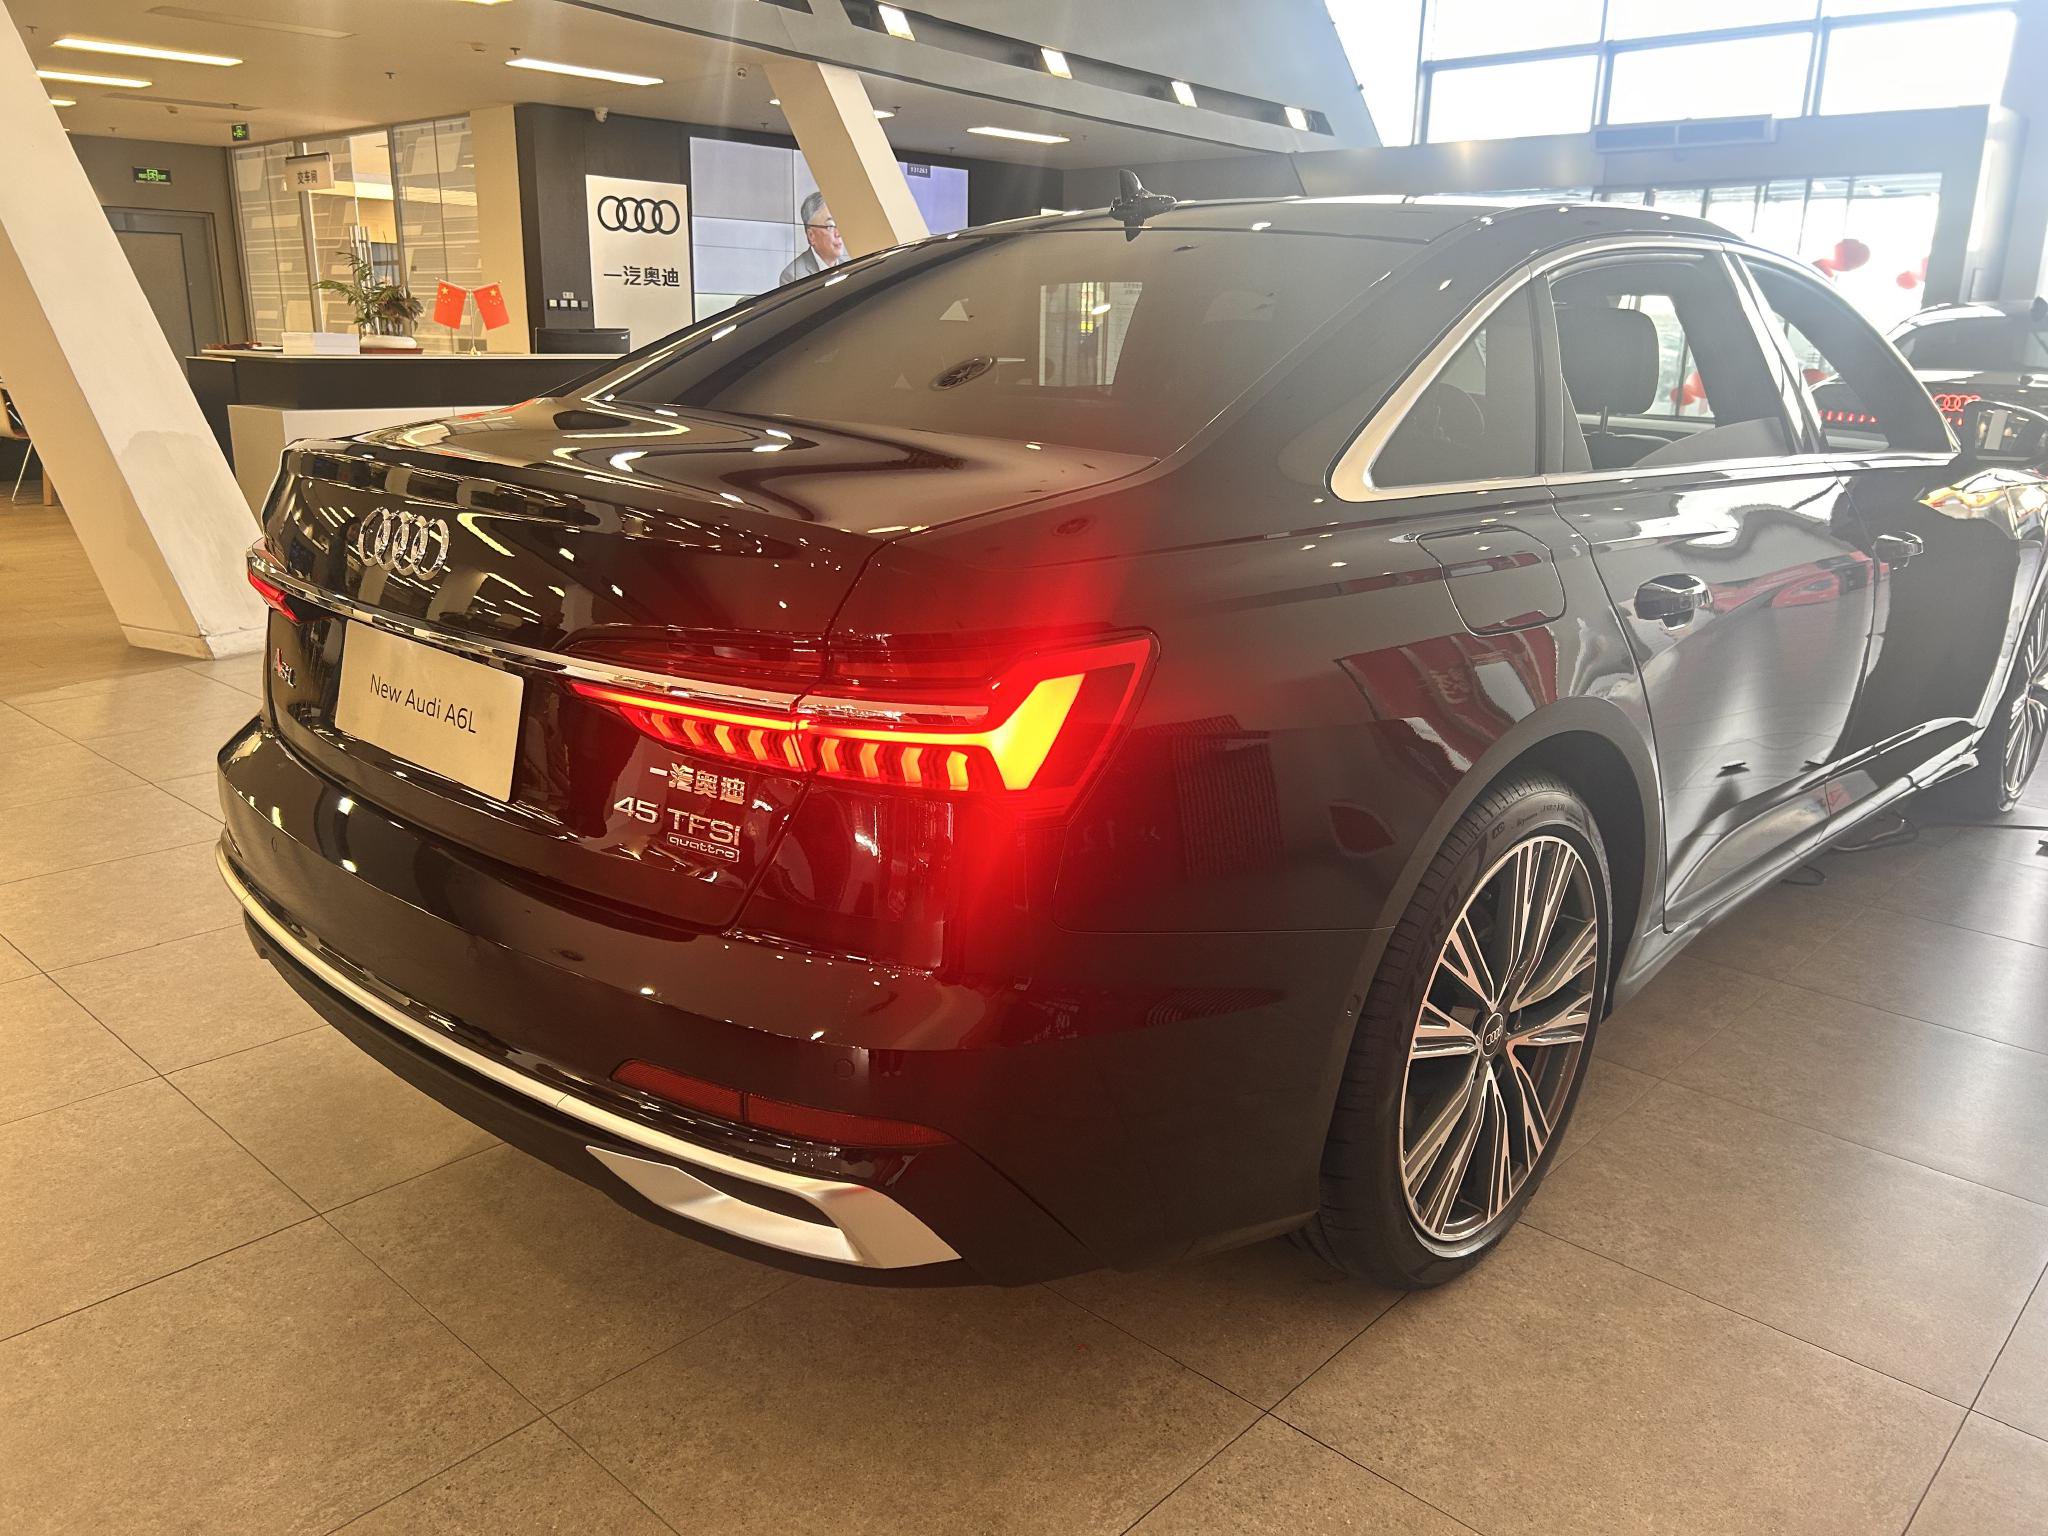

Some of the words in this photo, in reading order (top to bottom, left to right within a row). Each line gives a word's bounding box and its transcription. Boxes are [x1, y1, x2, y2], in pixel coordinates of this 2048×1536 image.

[603, 265, 681, 287] 一汽奥迪
[370, 673, 402, 704] New
[404, 688, 441, 719] Audi
[444, 704, 477, 734] A6L
[649, 762, 746, 805] 一汽奥迪
[613, 796, 660, 825] 45
[669, 835, 736, 859] quattro
